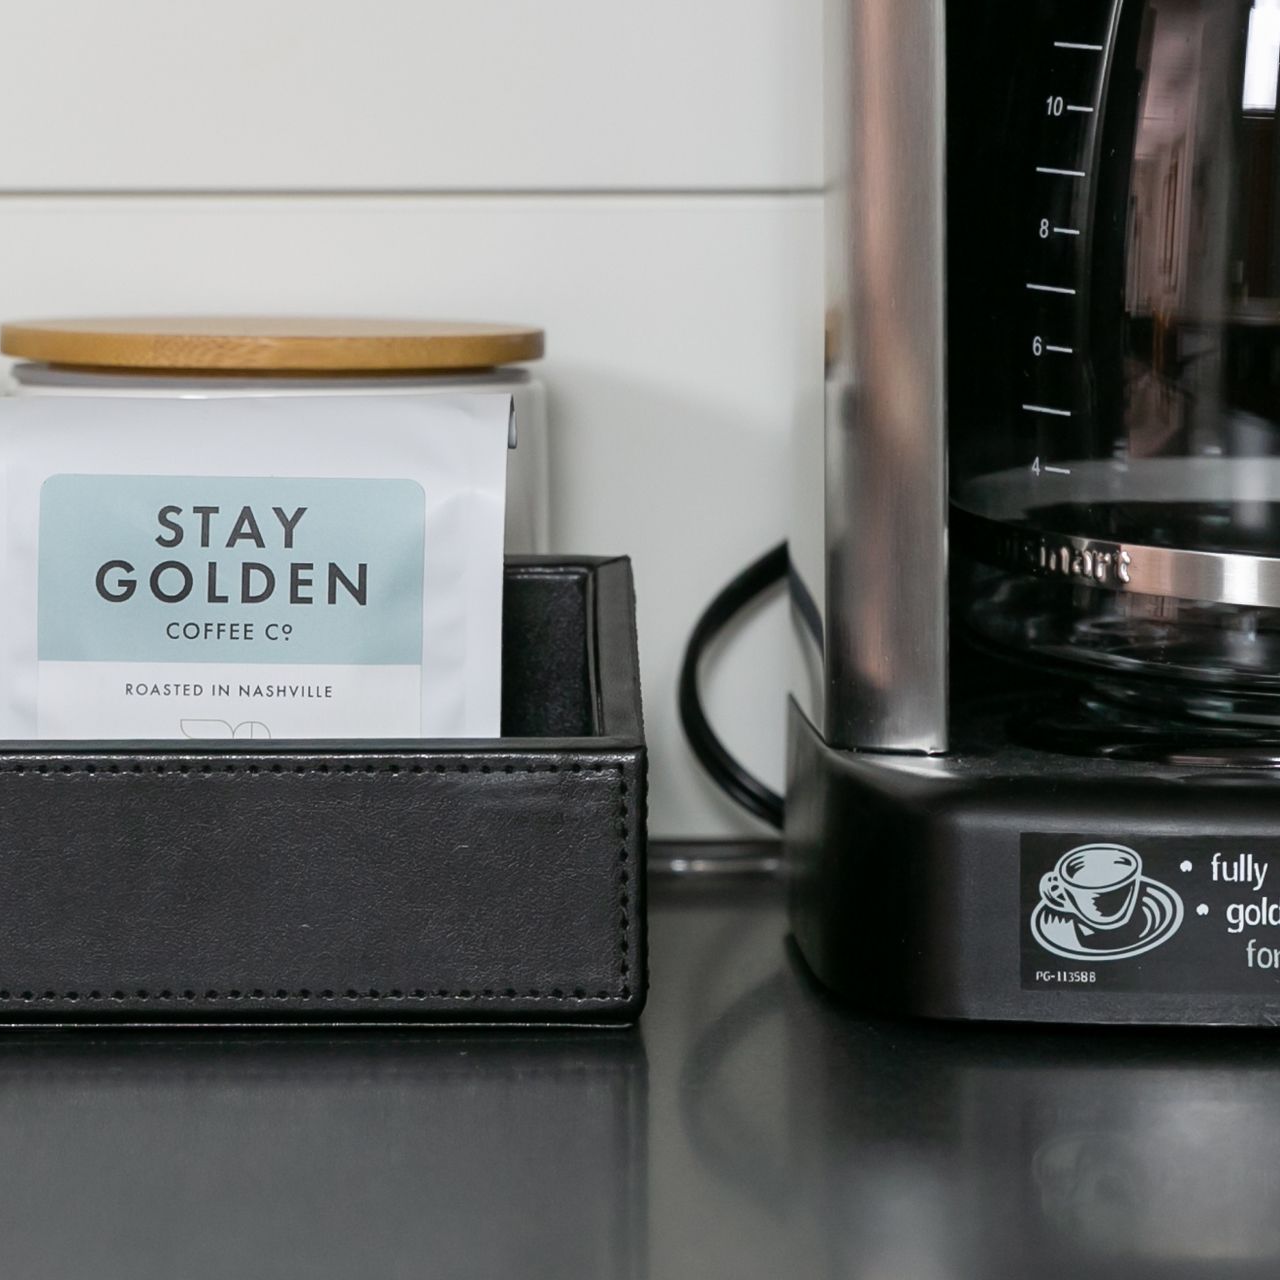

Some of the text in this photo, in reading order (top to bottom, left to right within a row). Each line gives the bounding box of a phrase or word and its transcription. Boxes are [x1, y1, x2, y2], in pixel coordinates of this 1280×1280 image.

[1045, 96, 1064, 116] 10
[1038, 219, 1049, 239] 8
[1031, 336, 1042, 356] 6
[1030, 455, 1041, 476] 4
[154, 504, 308, 550] STAY
[94, 558, 369, 607] GOLDEN
[165, 621, 255, 641] COFFEE
[124, 682, 333, 699] ROASTED IN NASHVILLE
[1210, 851, 1269, 892] fully
